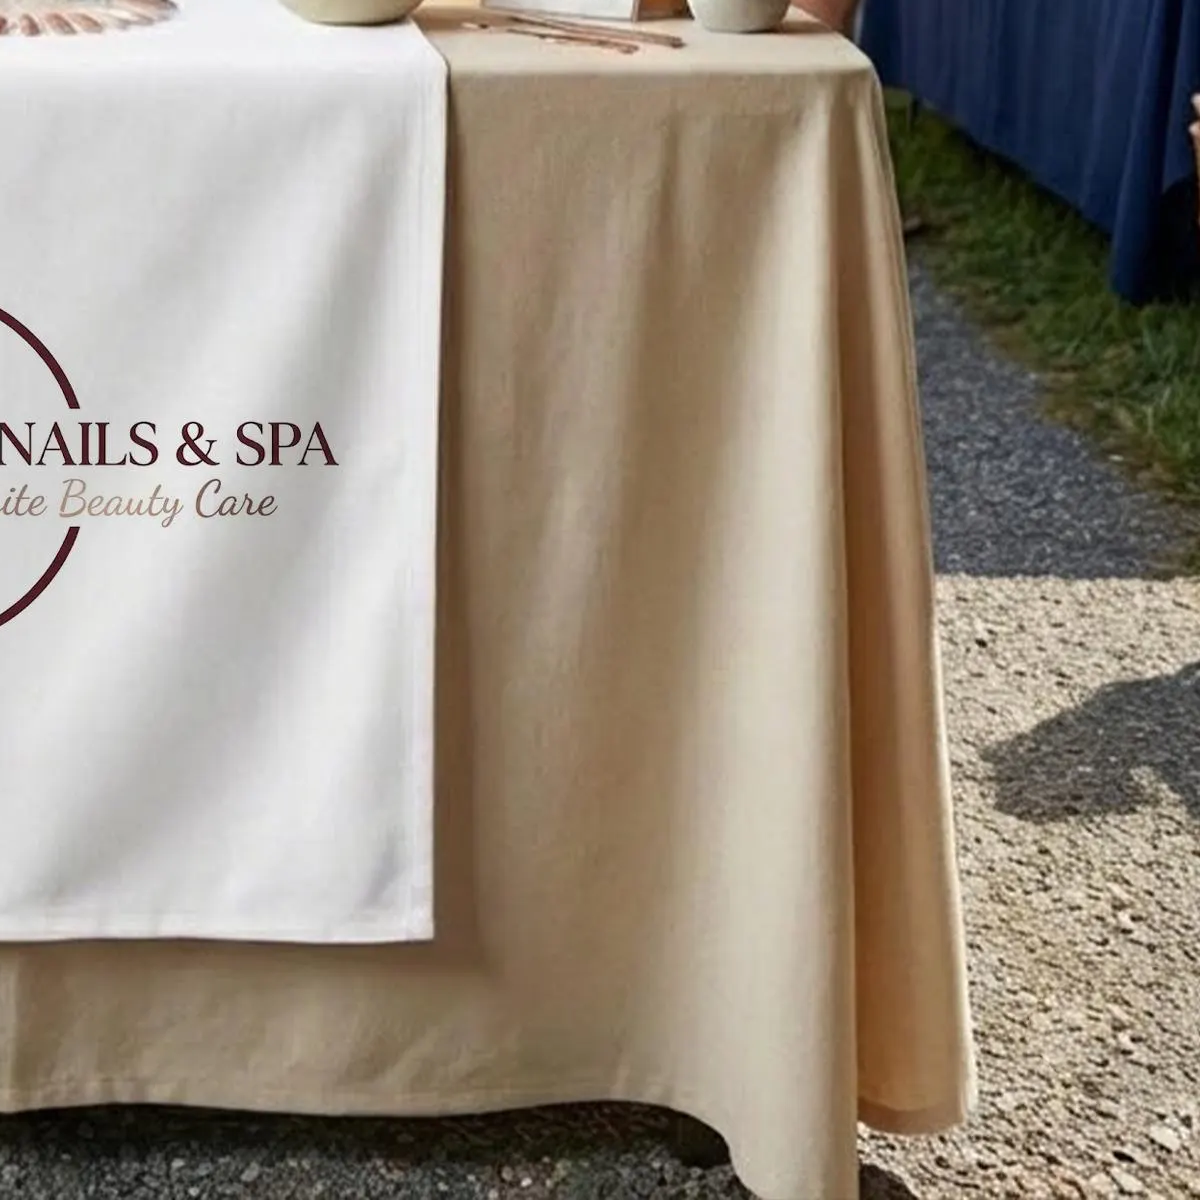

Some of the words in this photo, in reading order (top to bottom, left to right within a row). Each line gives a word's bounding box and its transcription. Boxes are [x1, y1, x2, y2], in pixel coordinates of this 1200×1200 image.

[175, 420, 221, 467] &
[235, 420, 340, 467] SPA
[58, 478, 185, 528] Beauty
[195, 478, 279, 519] Care
